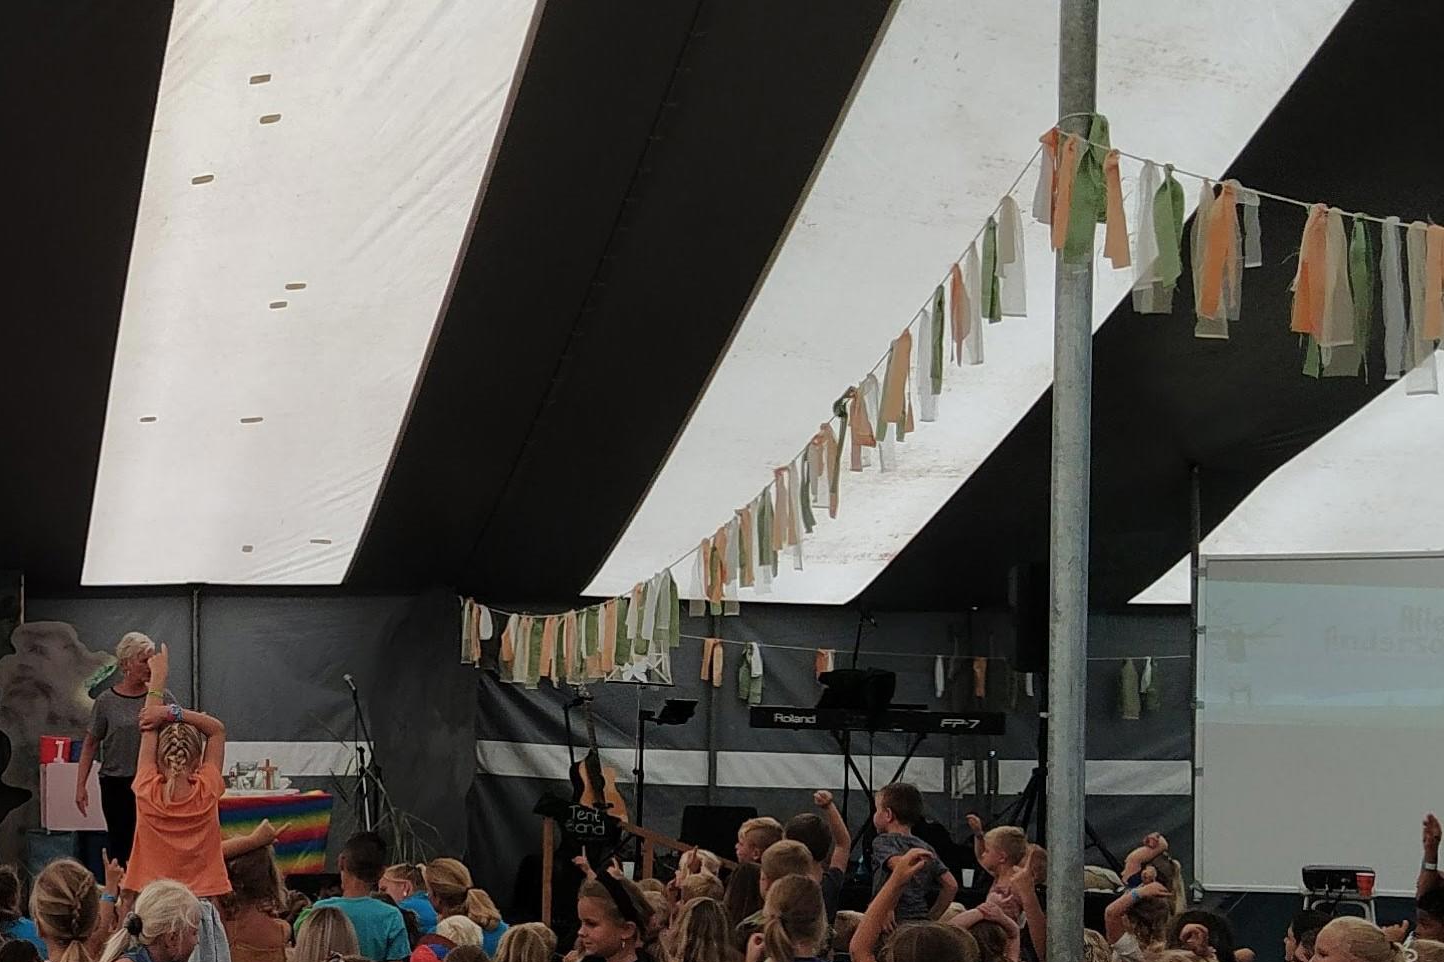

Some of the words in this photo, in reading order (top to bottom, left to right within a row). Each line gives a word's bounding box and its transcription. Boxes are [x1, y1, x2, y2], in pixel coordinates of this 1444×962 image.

[773, 712, 817, 724] Roland
[940, 718, 981, 729] FP-7
[53, 740, 65, 763] 1
[568, 804, 601, 823] Tent
